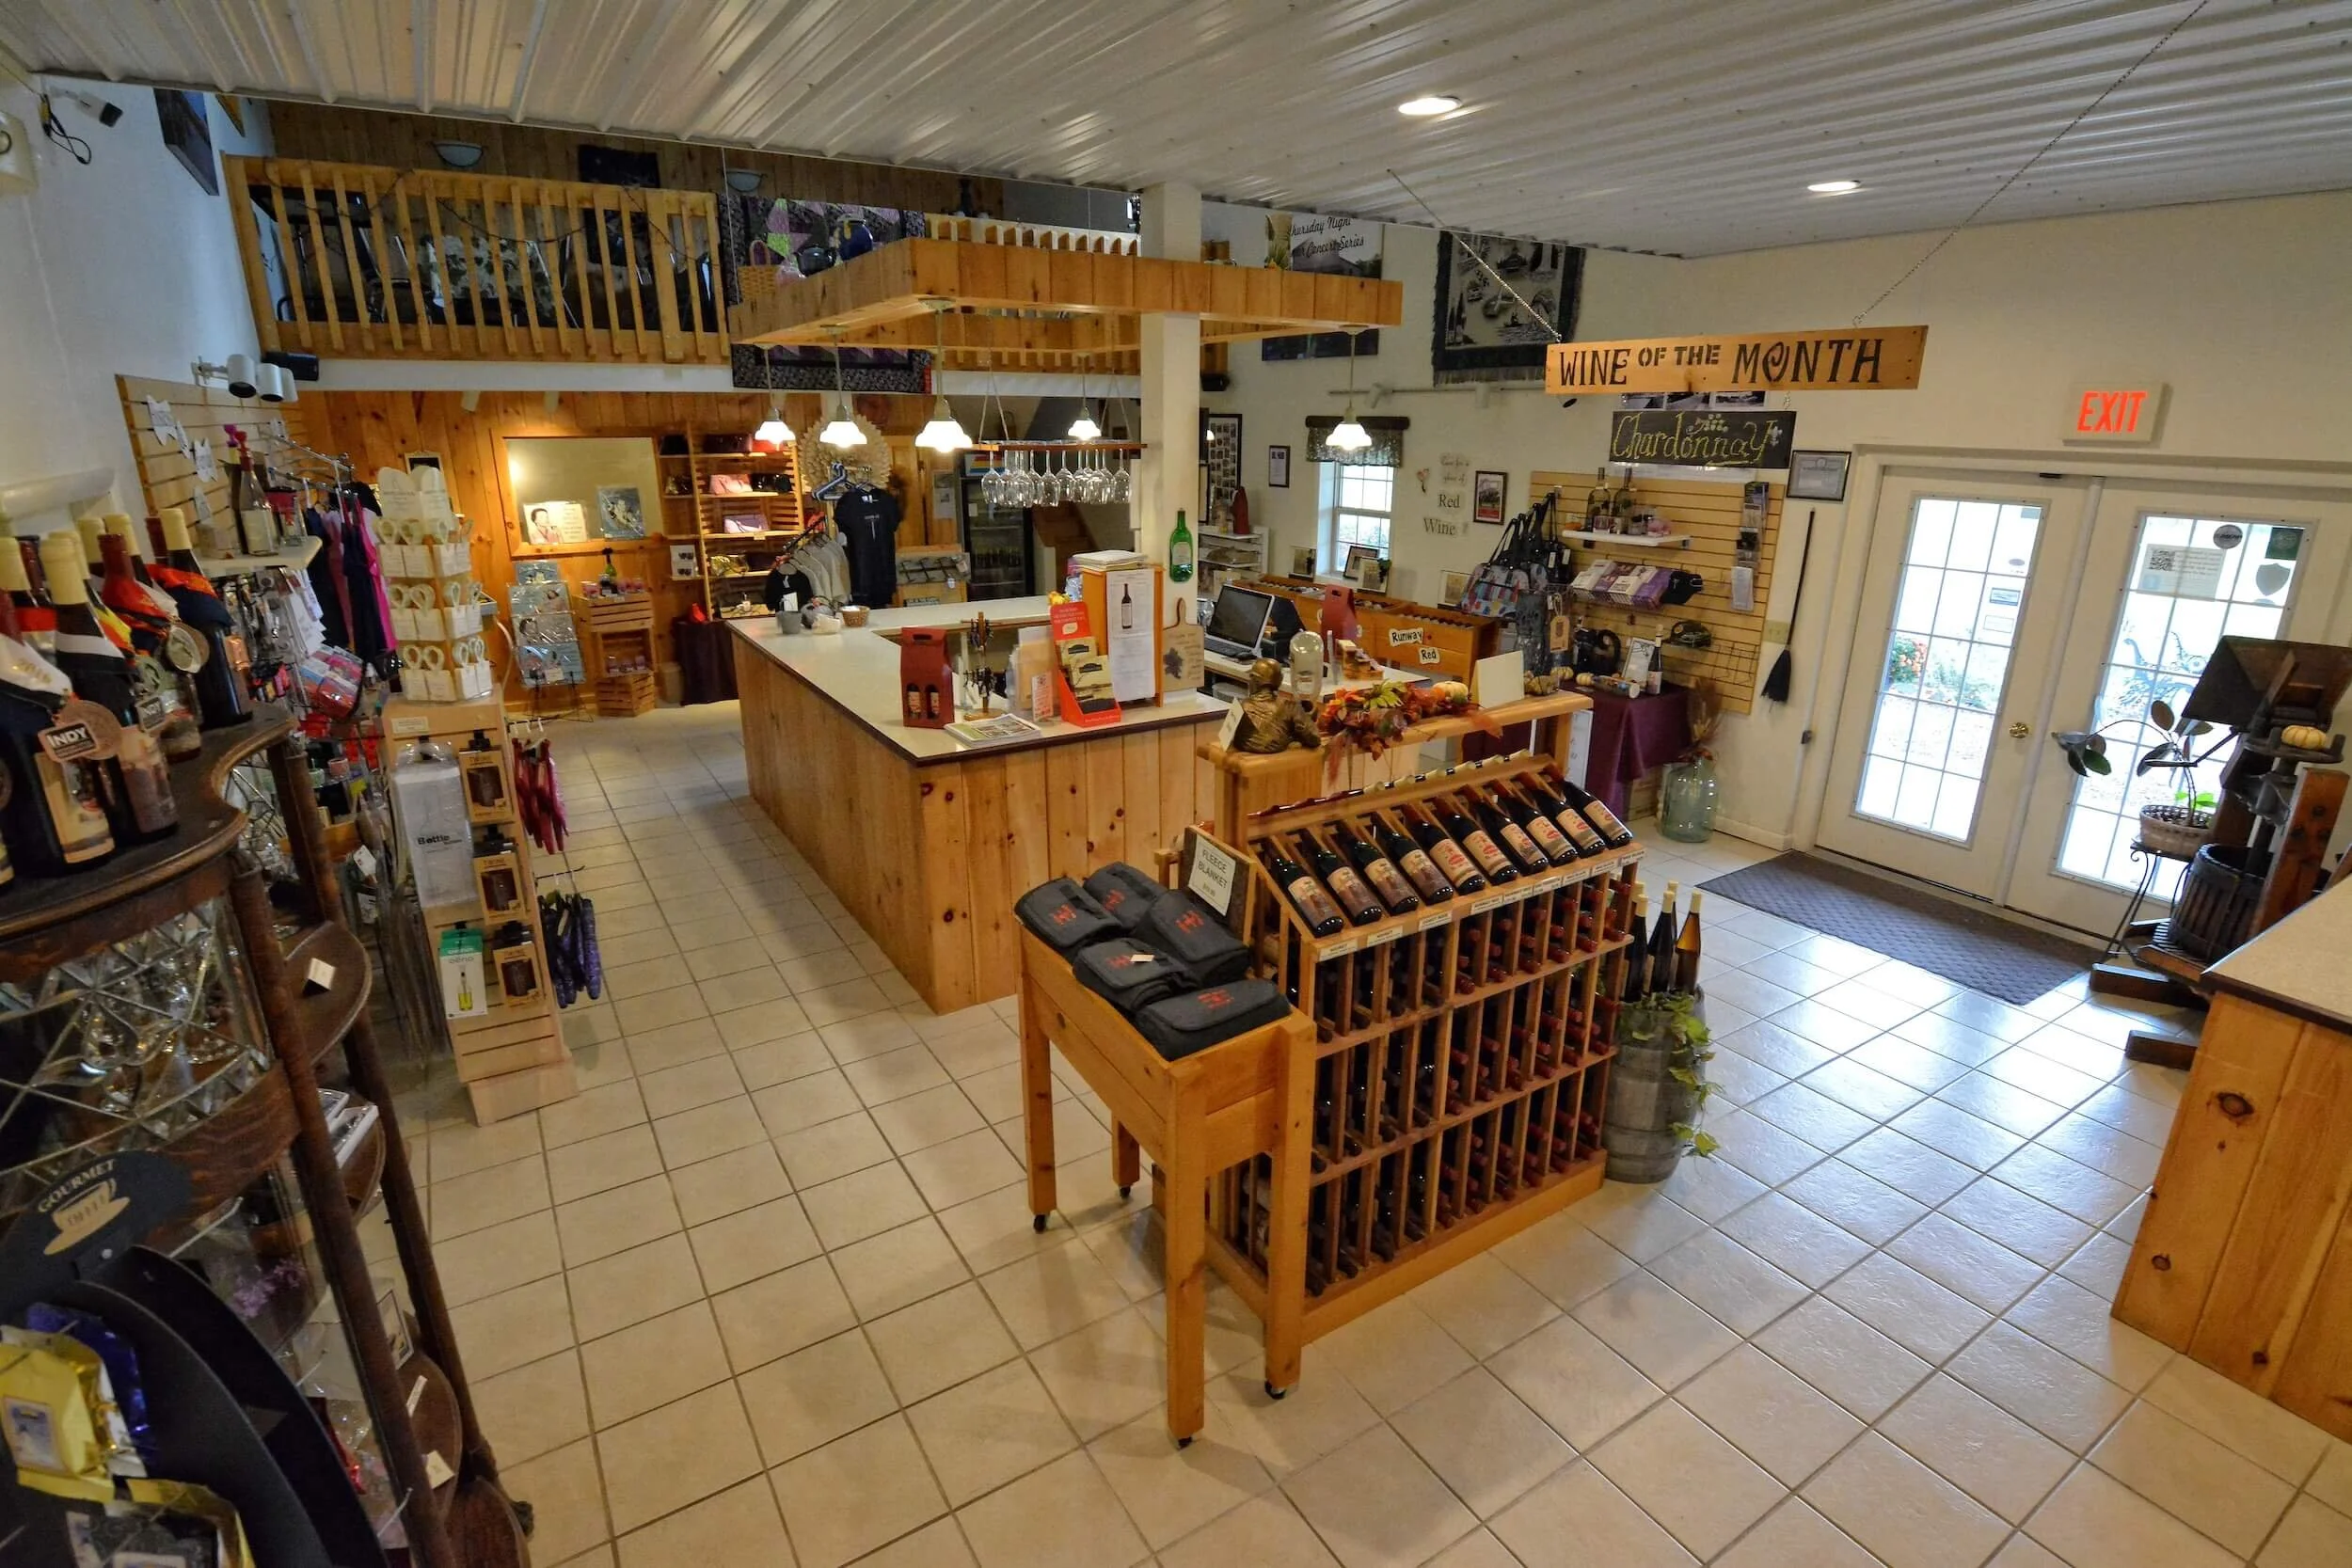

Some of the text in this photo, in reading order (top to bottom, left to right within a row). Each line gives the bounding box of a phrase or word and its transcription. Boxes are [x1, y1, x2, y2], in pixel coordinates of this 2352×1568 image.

[1291, 218, 1326, 236] hursday
[1339, 233, 1364, 251] Series
[1559, 338, 1884, 387] WINE OF THE MONTH
[2076, 390, 2148, 433] EXIT
[1438, 493, 1460, 509] Red
[1423, 517, 1456, 536] Wine
[1391, 631, 1422, 643] Runway
[1421, 648, 1437, 660] Red
[48, 726, 88, 747] INDY
[1202, 849, 1228, 874] FLEECE
[1198, 860, 1228, 889] BLANKET
[38, 1158, 117, 1213] GOURMET
